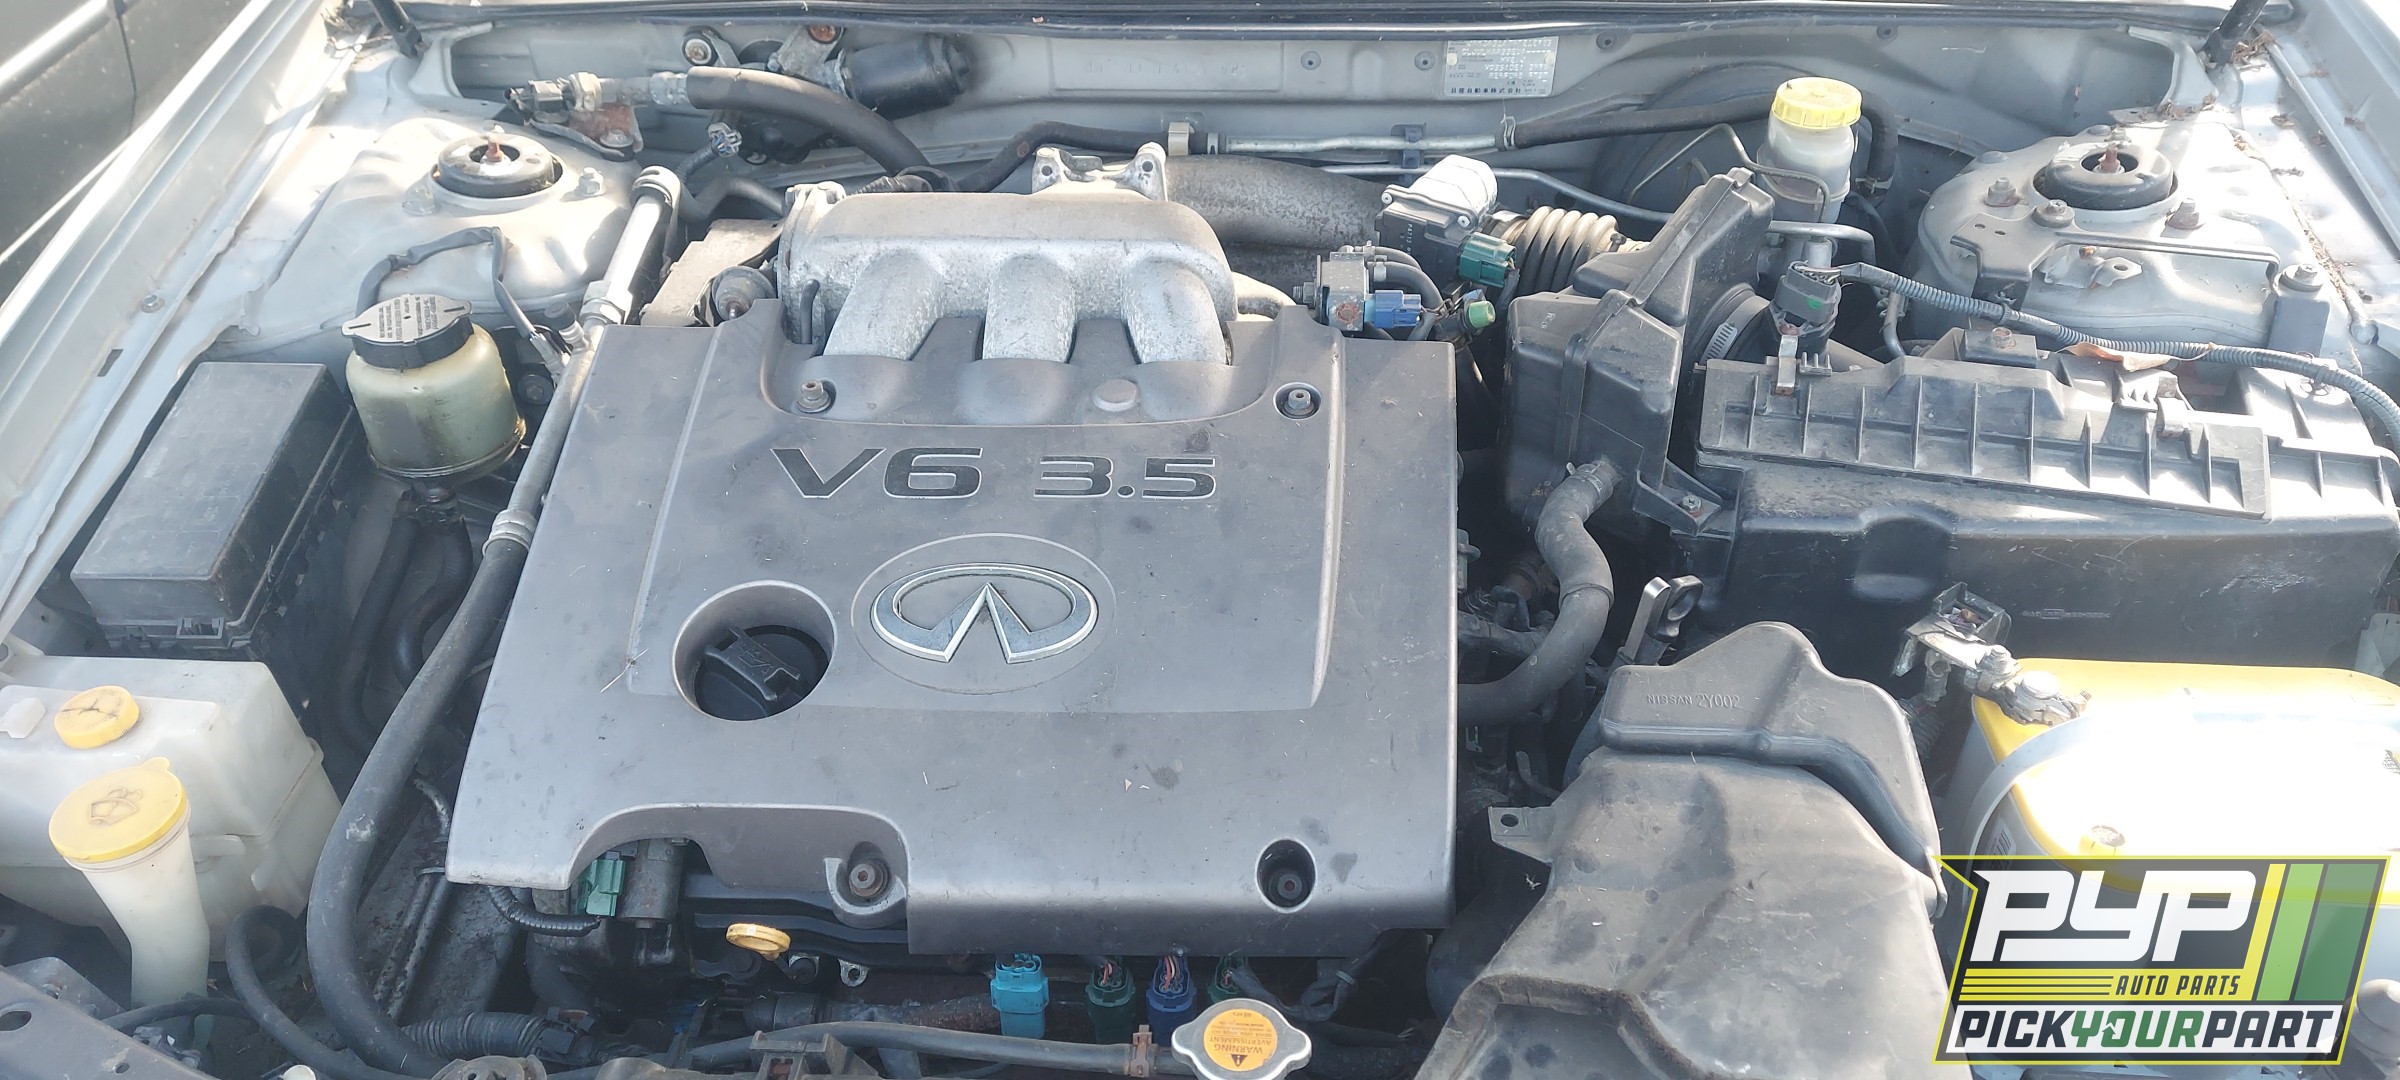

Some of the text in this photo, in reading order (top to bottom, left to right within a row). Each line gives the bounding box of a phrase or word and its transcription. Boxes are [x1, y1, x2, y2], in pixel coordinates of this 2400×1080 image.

[770, 447, 1217, 499] V6 3.5
[1647, 694, 1741, 709] NISSAN 2Y002
[1214, 1043, 1263, 1054] WARNING
